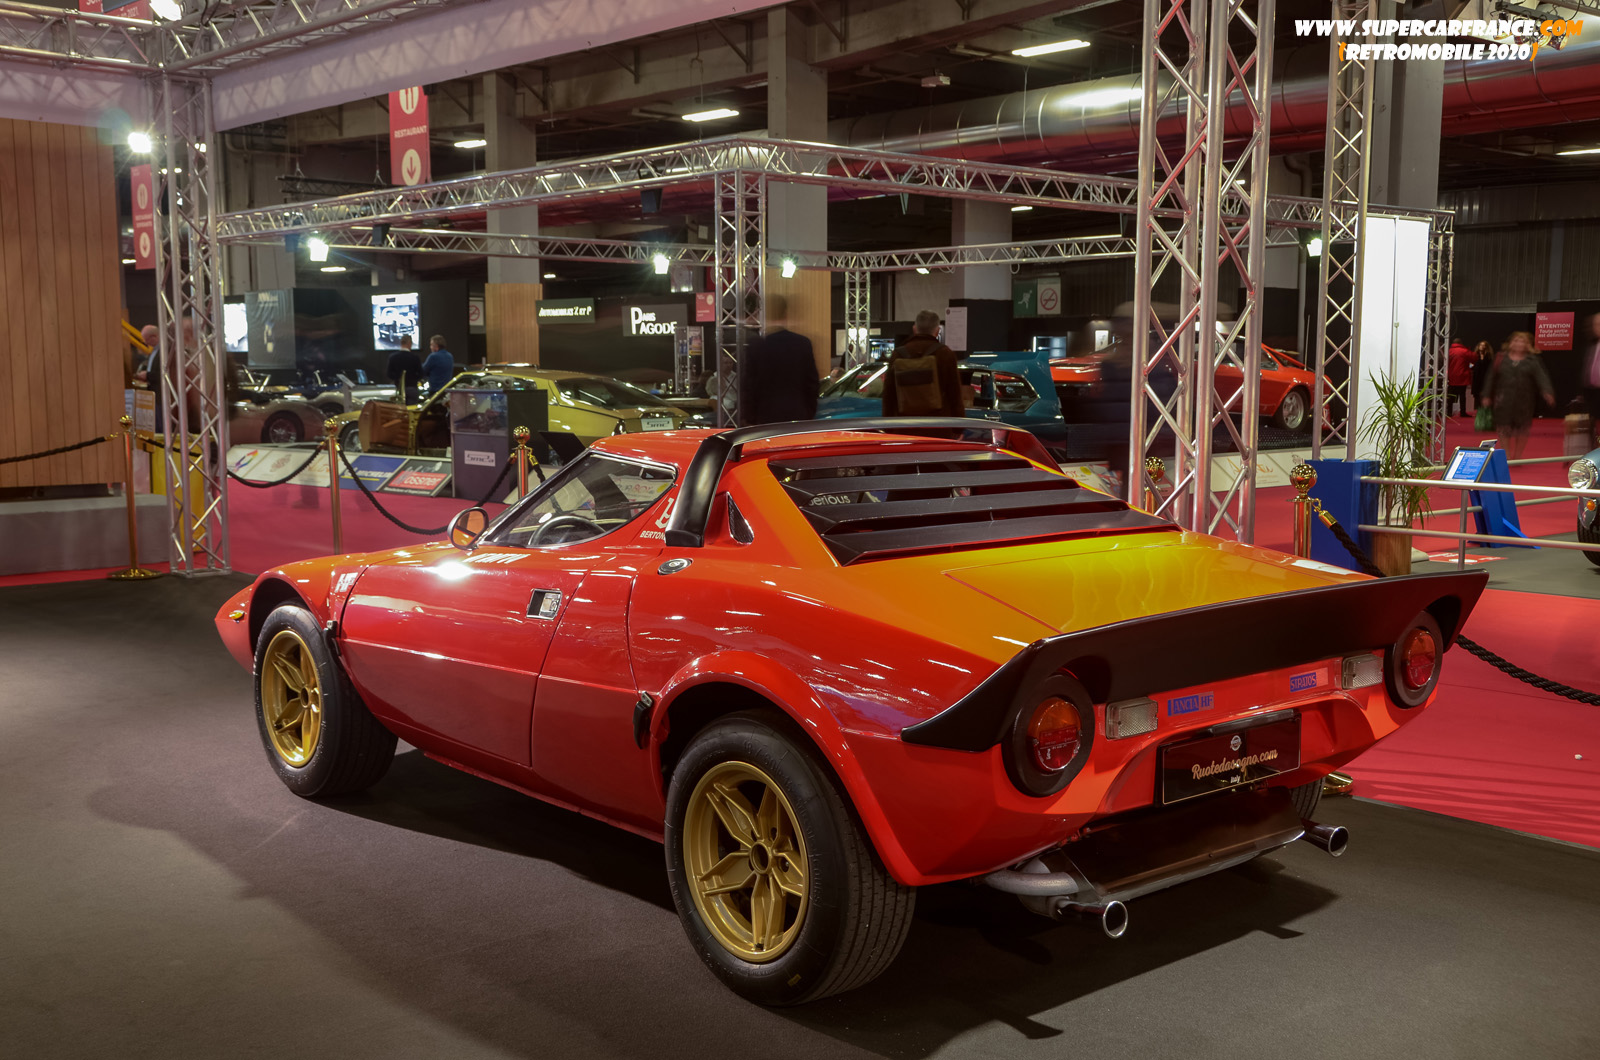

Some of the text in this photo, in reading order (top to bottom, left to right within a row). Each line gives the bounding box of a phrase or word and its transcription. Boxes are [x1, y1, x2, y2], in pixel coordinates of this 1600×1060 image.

[394, 125, 427, 139] RESTAURANT
[586, 305, 592, 316] P
[639, 530, 665, 540] BERTON
[1290, 673, 1317, 692] STRATOS
[1200, 693, 1214, 708] HF
[1191, 748, 1279, 780] Ruotedasogno.com
